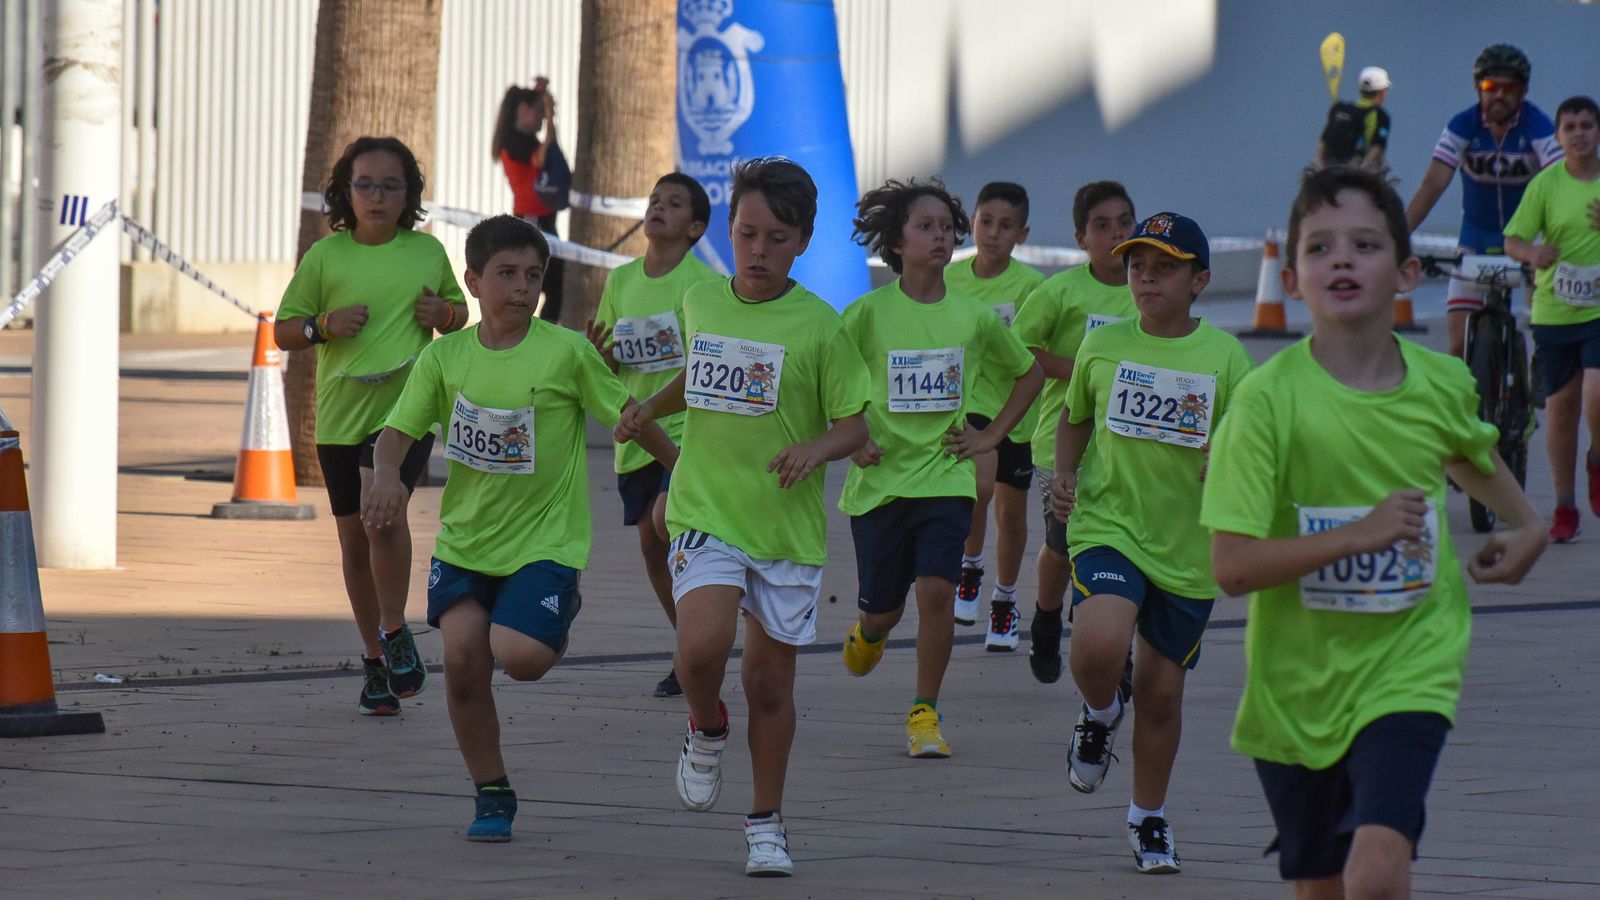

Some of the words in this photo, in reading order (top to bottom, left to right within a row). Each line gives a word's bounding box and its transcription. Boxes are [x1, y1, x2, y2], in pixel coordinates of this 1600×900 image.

[1468, 157, 1530, 176] UCA
[1558, 278, 1592, 296] 1103
[617, 338, 656, 359] 1315
[693, 339, 707, 351] XXI
[740, 345, 764, 353] MIGUEL
[892, 356, 905, 365] XXI
[691, 360, 745, 393] 1320
[895, 372, 944, 394] 1144
[1119, 368, 1136, 381] XXI
[1137, 371, 1155, 380] Carrera
[1136, 377, 1155, 385] Popular
[1117, 389, 1177, 423] 1322
[453, 421, 502, 456] 1365
[1307, 517, 1332, 533] XXI
[540, 600, 560, 615] adidas
